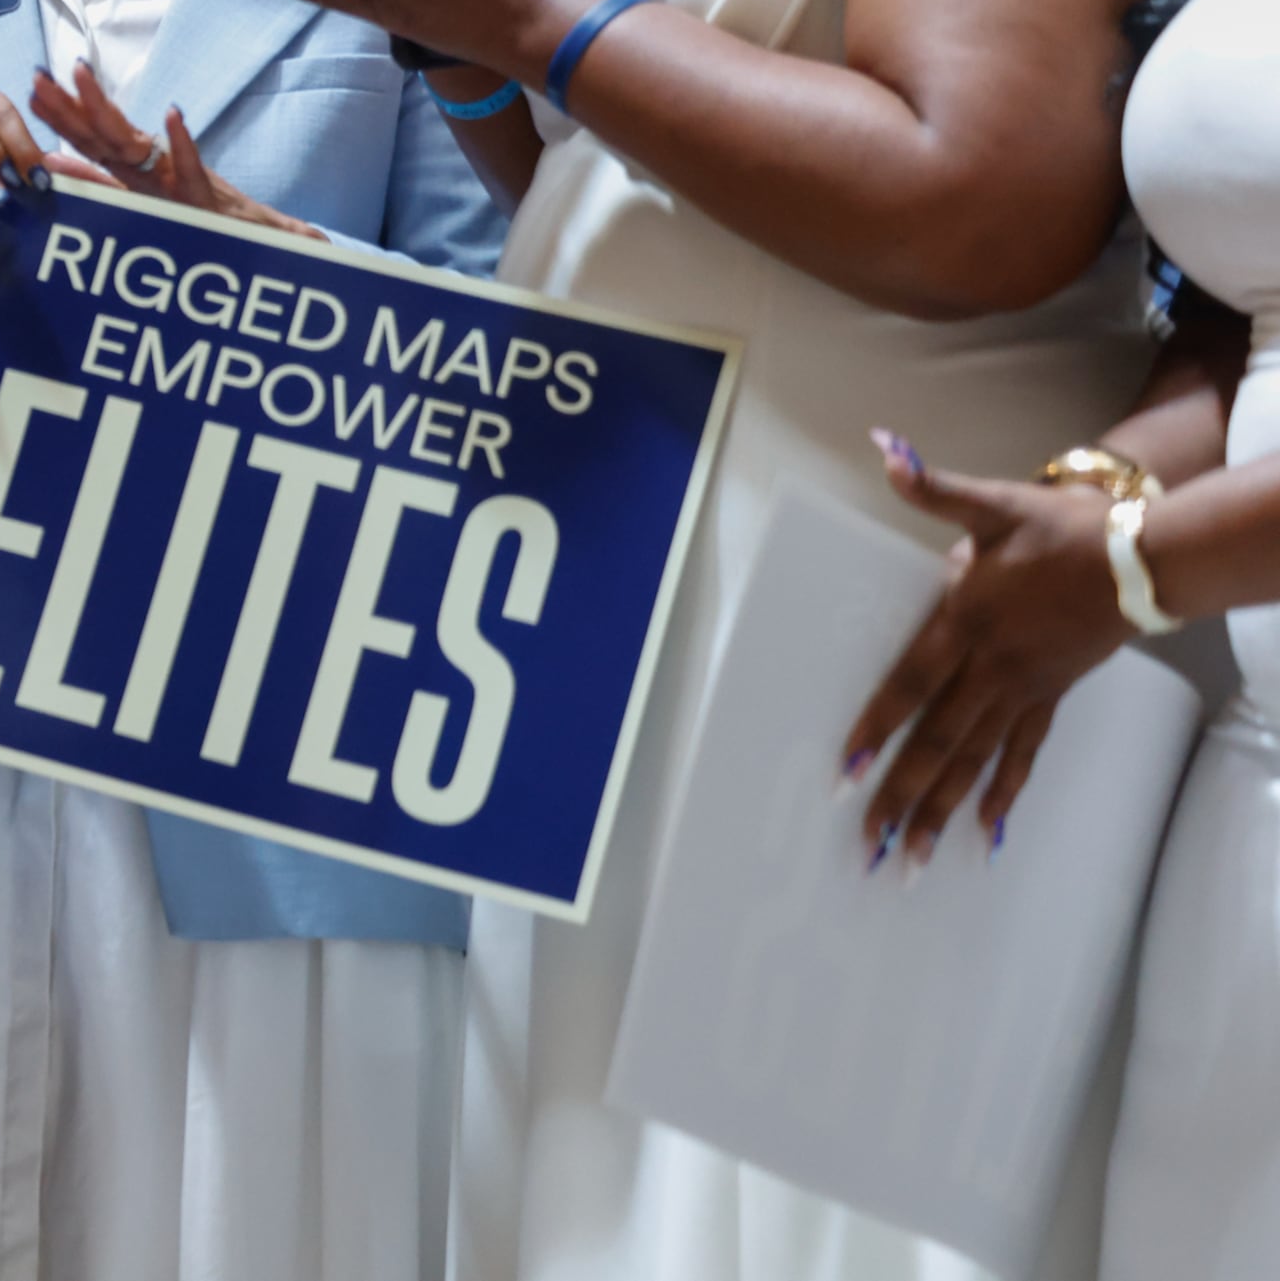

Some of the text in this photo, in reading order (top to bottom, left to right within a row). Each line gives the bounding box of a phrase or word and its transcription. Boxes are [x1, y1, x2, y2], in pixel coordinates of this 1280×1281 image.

[37, 223, 597, 414] RIGGED MAPS
[81, 314, 511, 478] EMPOWER
